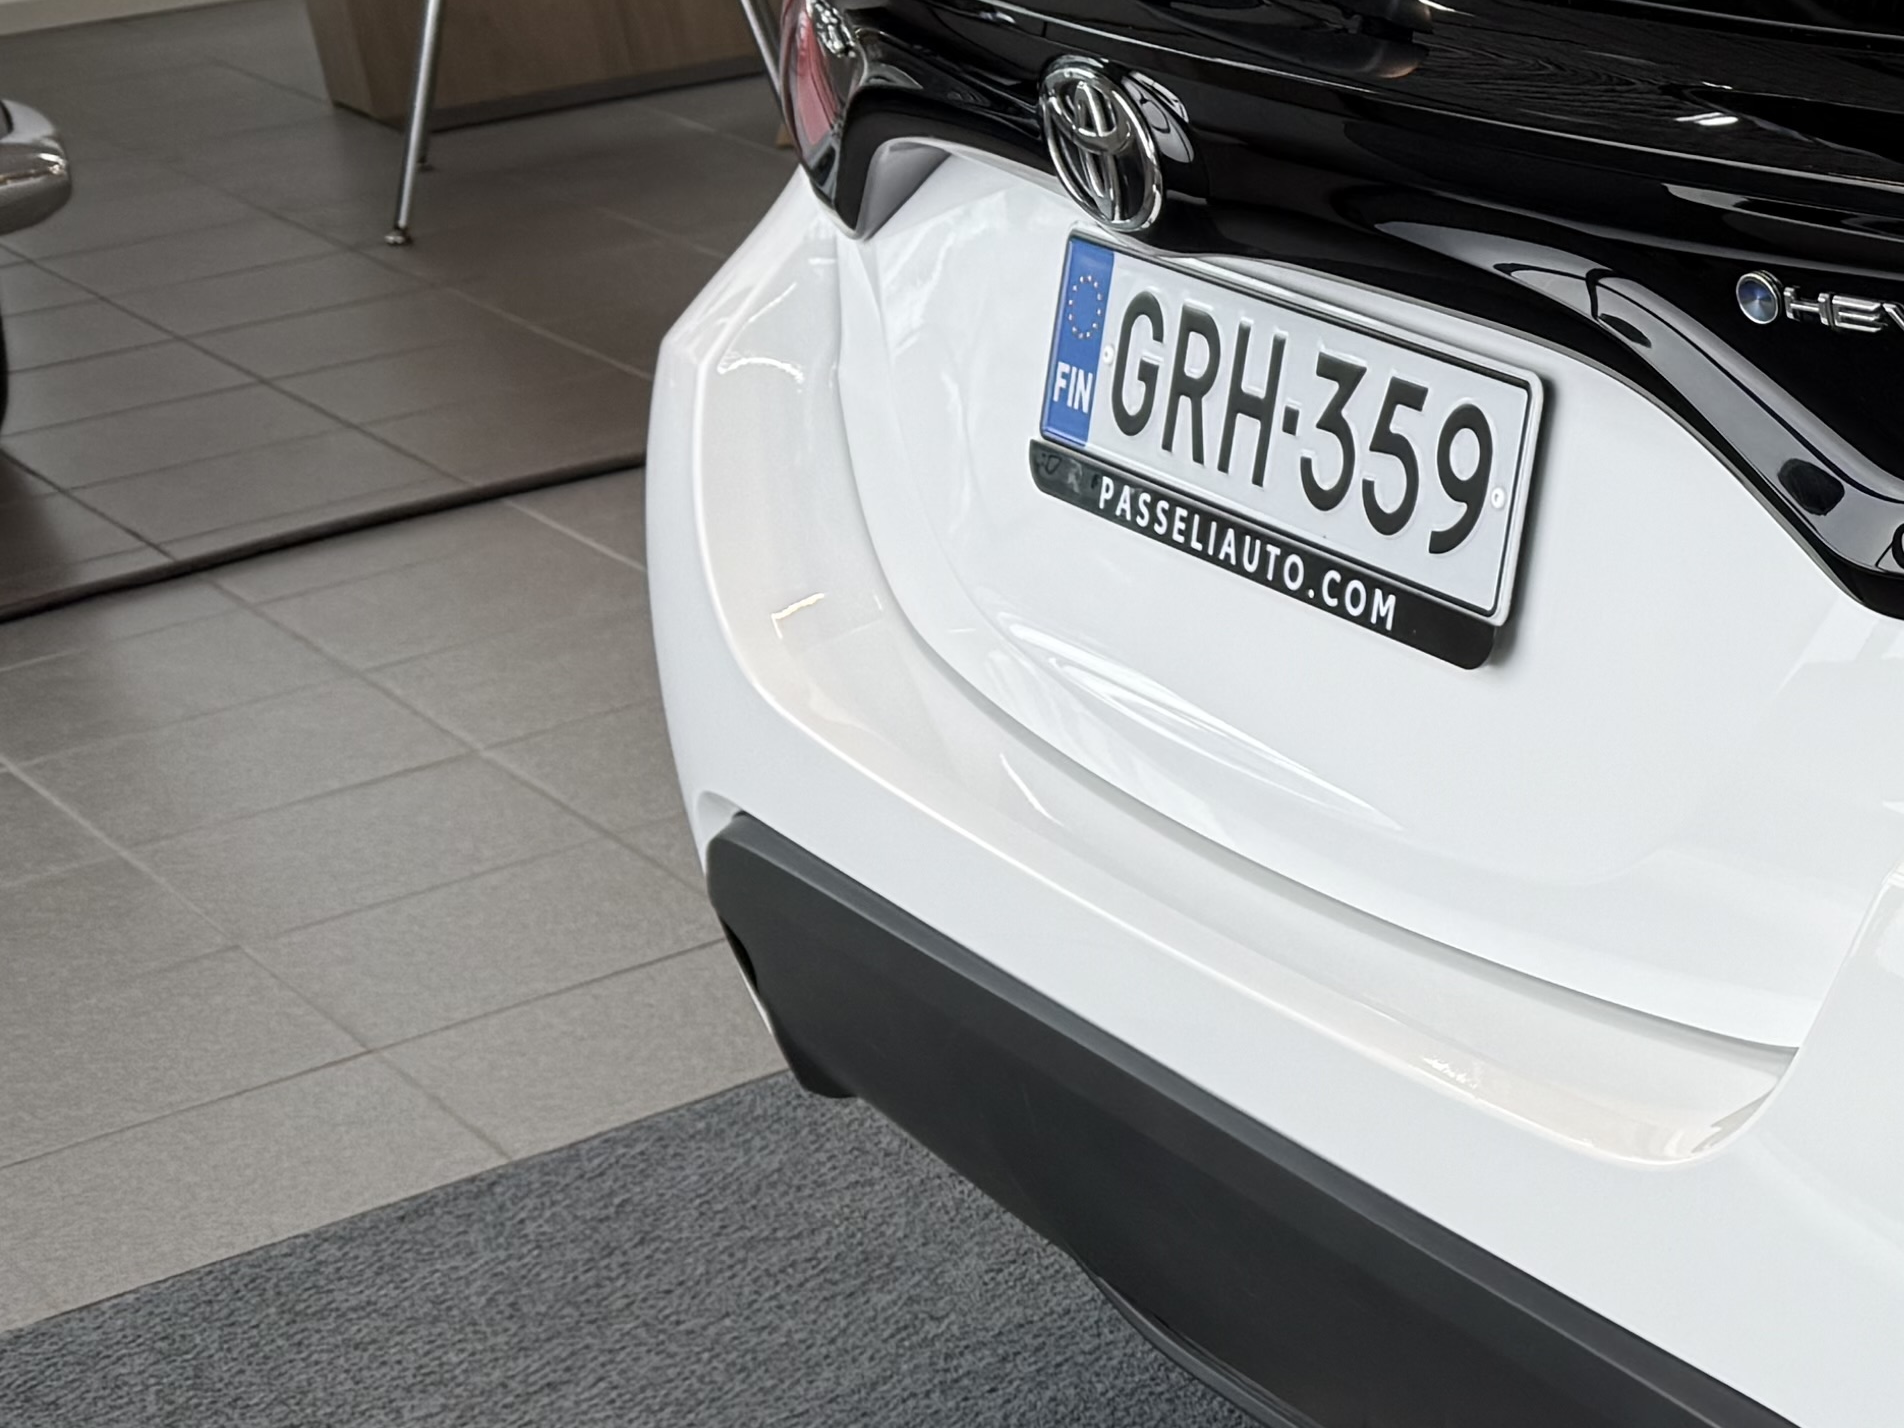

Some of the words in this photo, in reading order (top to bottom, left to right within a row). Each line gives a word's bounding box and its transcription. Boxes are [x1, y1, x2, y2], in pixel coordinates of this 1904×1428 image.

[1053, 360, 1093, 415] FIN
[1111, 289, 1493, 555] GRH-359
[1098, 476, 1397, 632] PASSELIAUTO.COM
